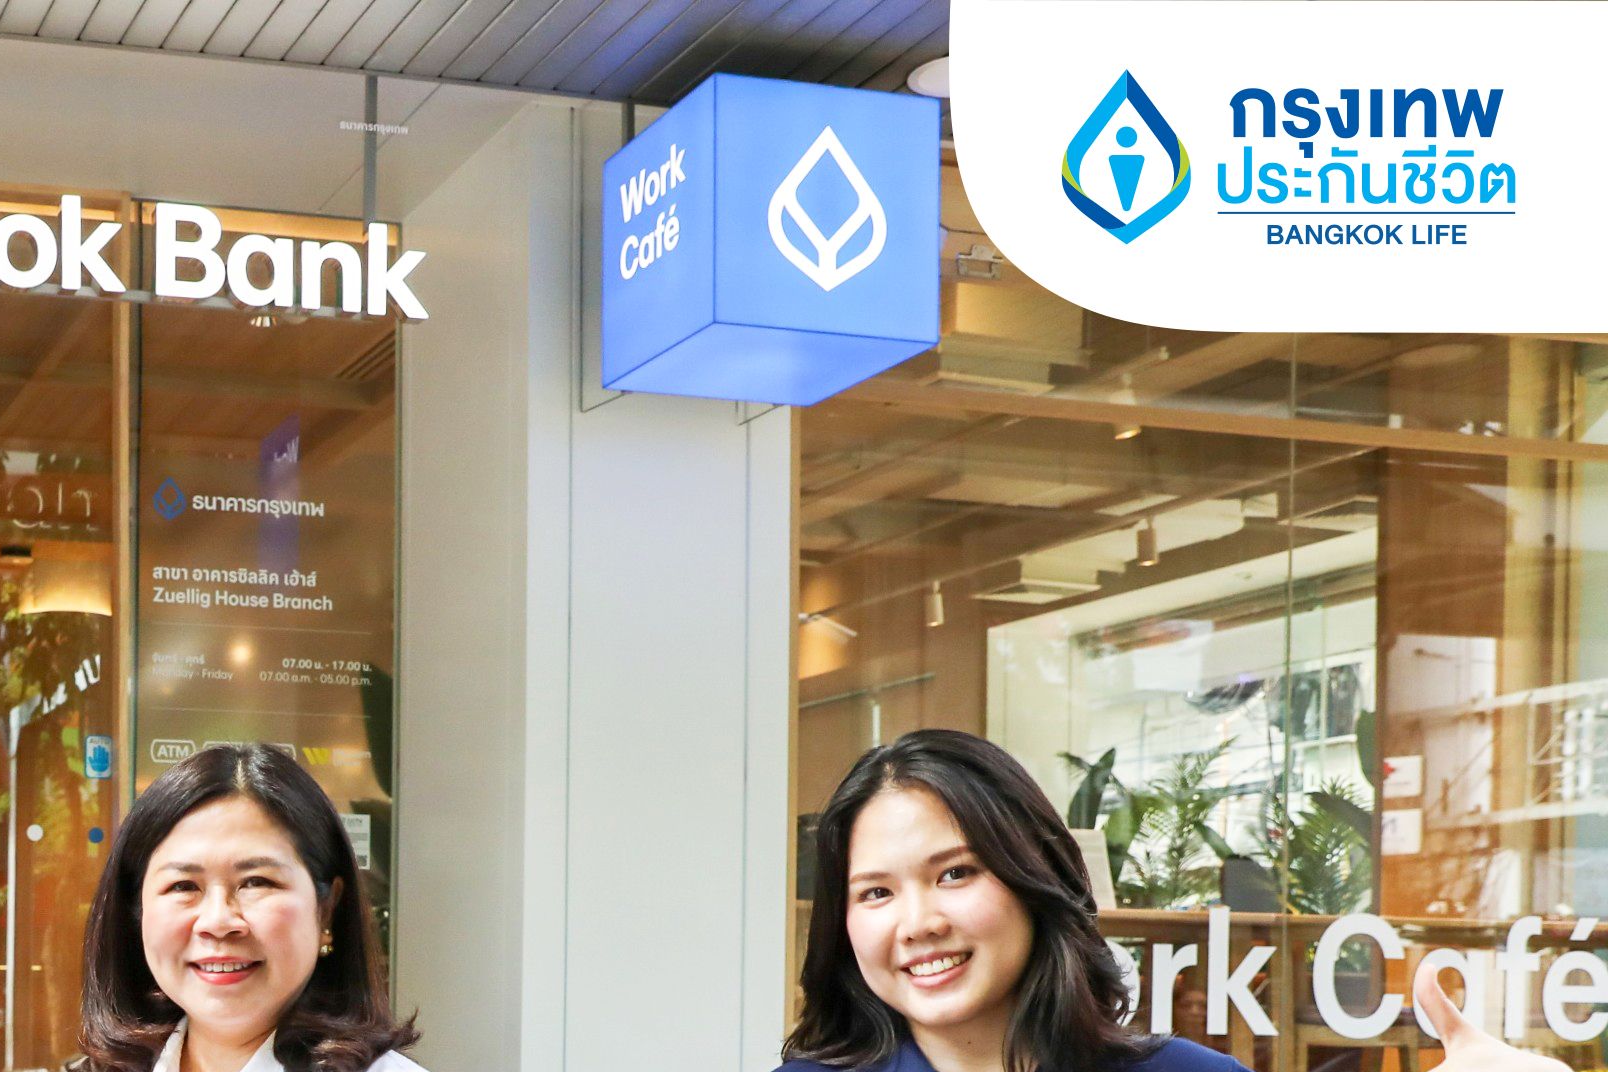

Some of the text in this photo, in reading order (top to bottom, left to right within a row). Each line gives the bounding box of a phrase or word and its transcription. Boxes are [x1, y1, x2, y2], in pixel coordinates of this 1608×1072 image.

[620, 144, 686, 224] Work
[619, 204, 681, 281] Café
[155, 202, 430, 322] Bank
[192, 495, 325, 519] ธนาคารกรุงเทพ
[152, 566, 188, 581] สาขา
[152, 587, 333, 611] Zuellig House Branch
[282, 658, 313, 670] 07.00
[332, 661, 361, 671] 17.00
[201, 669, 234, 681] Friday
[259, 671, 290, 682] 07.00
[319, 674, 350, 685] 05.00
[157, 744, 190, 757] ATM
